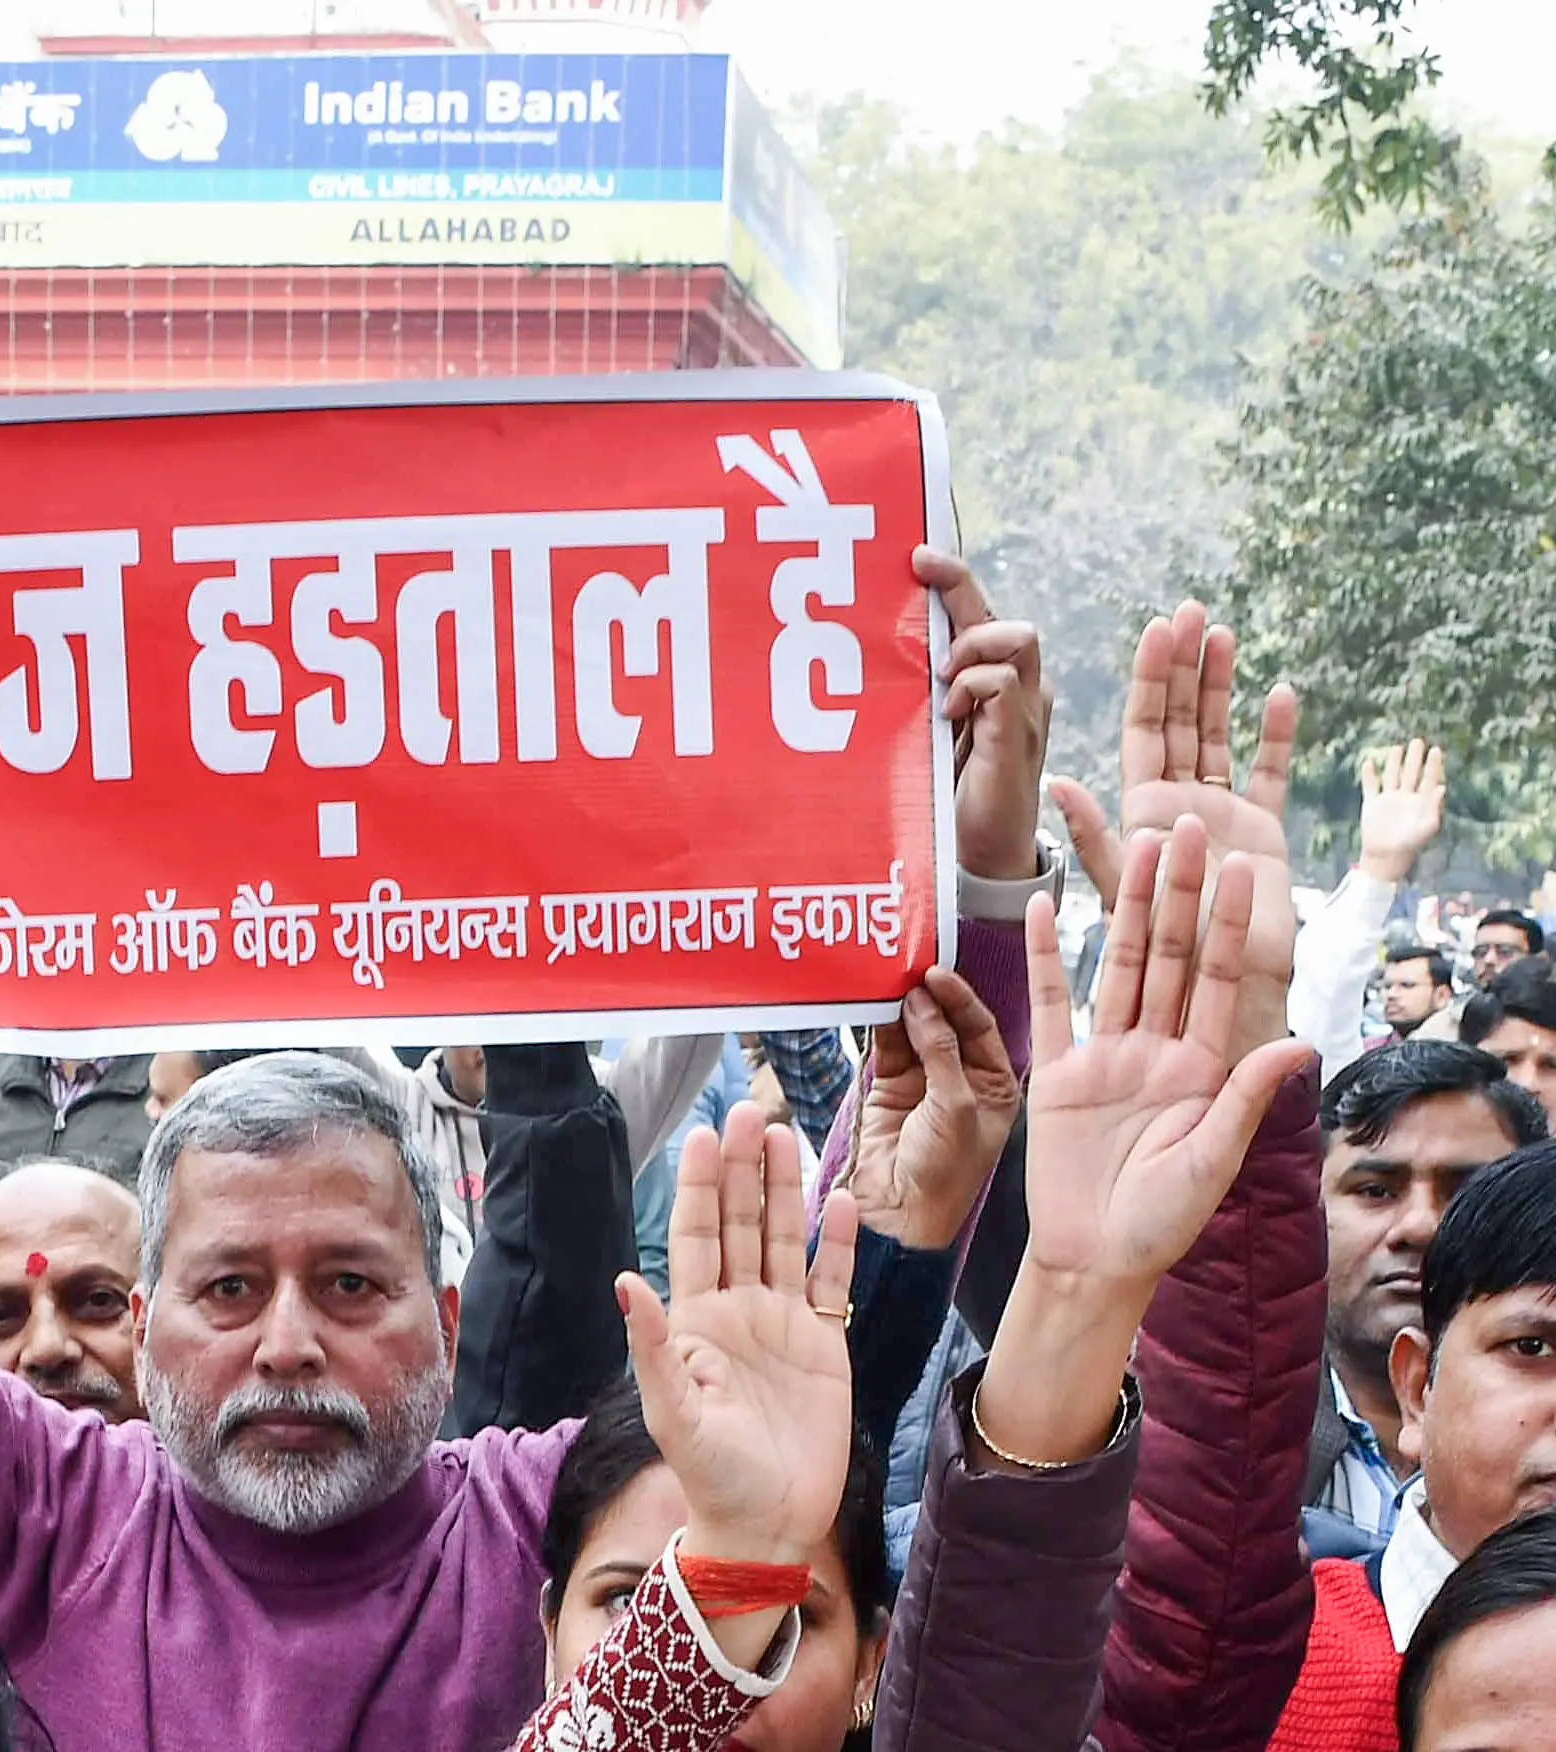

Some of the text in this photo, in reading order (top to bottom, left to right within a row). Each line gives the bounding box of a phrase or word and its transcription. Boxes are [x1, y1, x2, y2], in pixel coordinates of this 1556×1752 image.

[304, 79, 621, 125] Indian Bank
[309, 172, 615, 200] CIVIL LINES, PRAYAGRAJ
[349, 217, 571, 243] ALLAHABAD
[172, 507, 725, 857] हड़ताल
[717, 429, 876, 755] है
[110, 889, 220, 973] ऑफ
[230, 880, 319, 967] बैंक
[330, 878, 530, 990] यूनियन्स
[540, 886, 758, 965] प्रयागराज
[768, 860, 904, 959] इकाई
